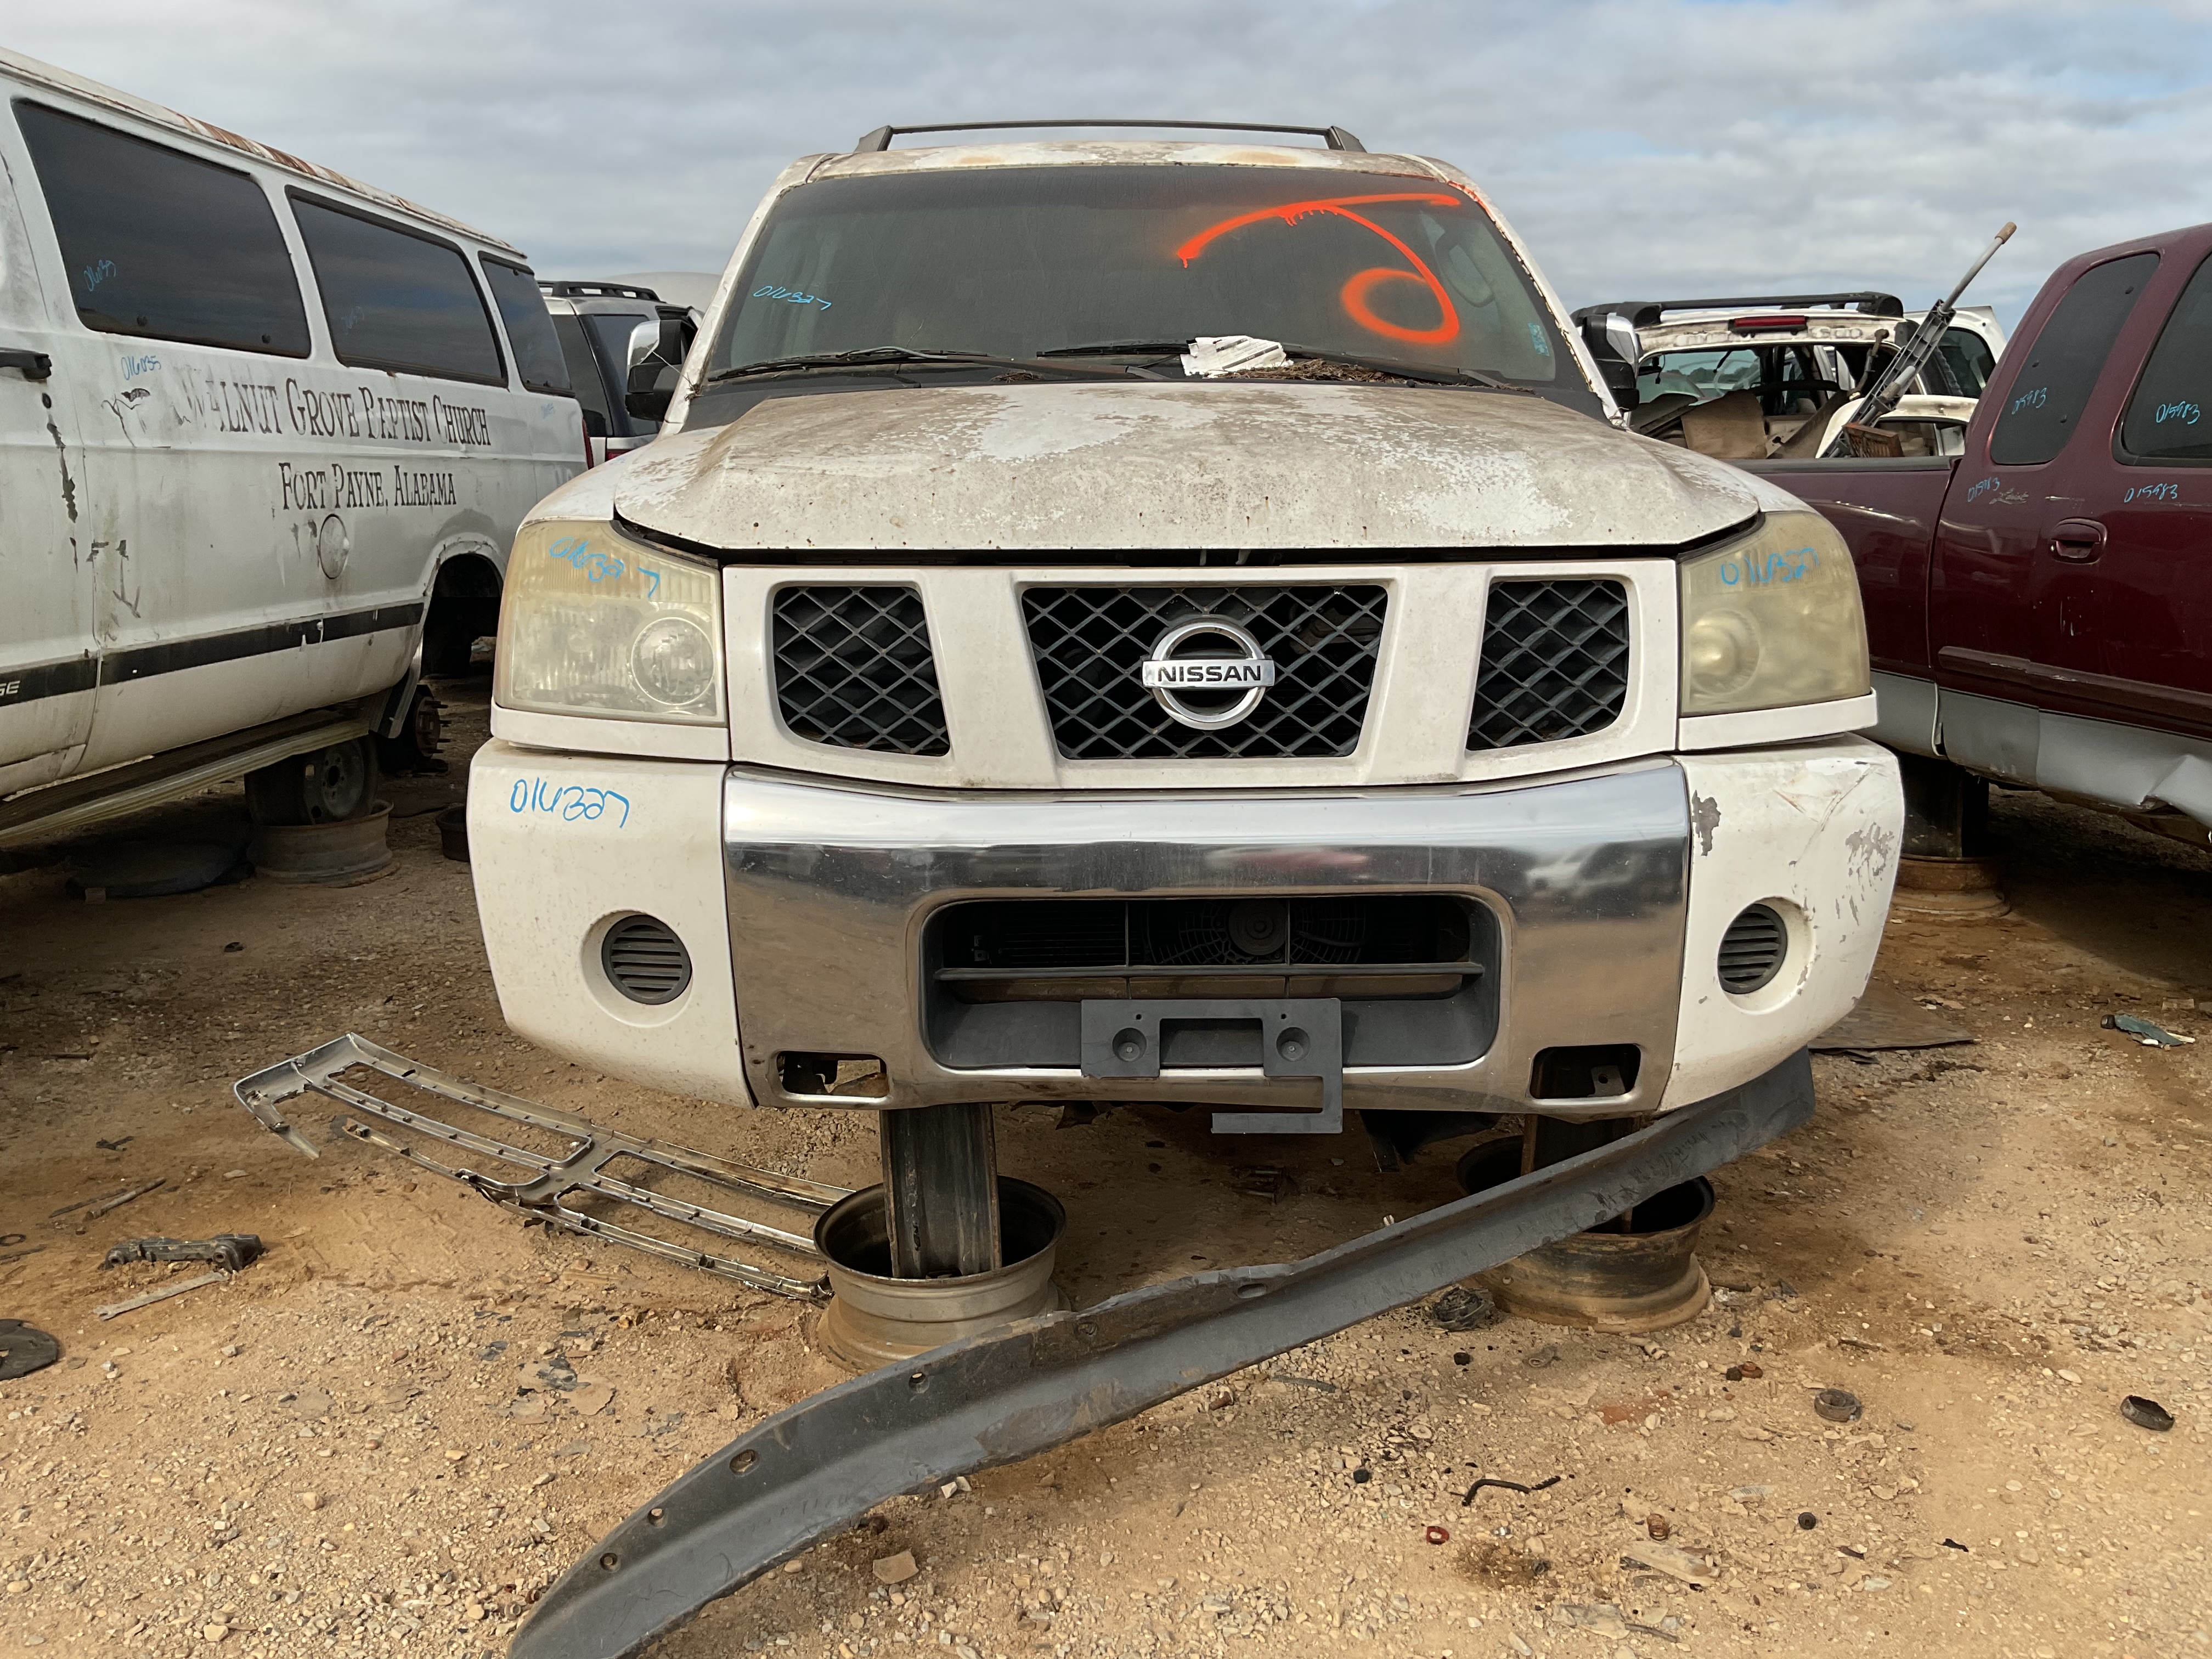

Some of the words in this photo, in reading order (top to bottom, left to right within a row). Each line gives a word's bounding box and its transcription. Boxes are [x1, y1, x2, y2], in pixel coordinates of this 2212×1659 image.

[285, 376, 360, 438] GROVE
[358, 386, 432, 442] BAPTIST
[432, 394, 492, 446] CHURCH
[278, 462, 326, 510] FORT
[393, 465, 457, 506] ALABAMA
[1158, 665, 1262, 682] NISSAN
